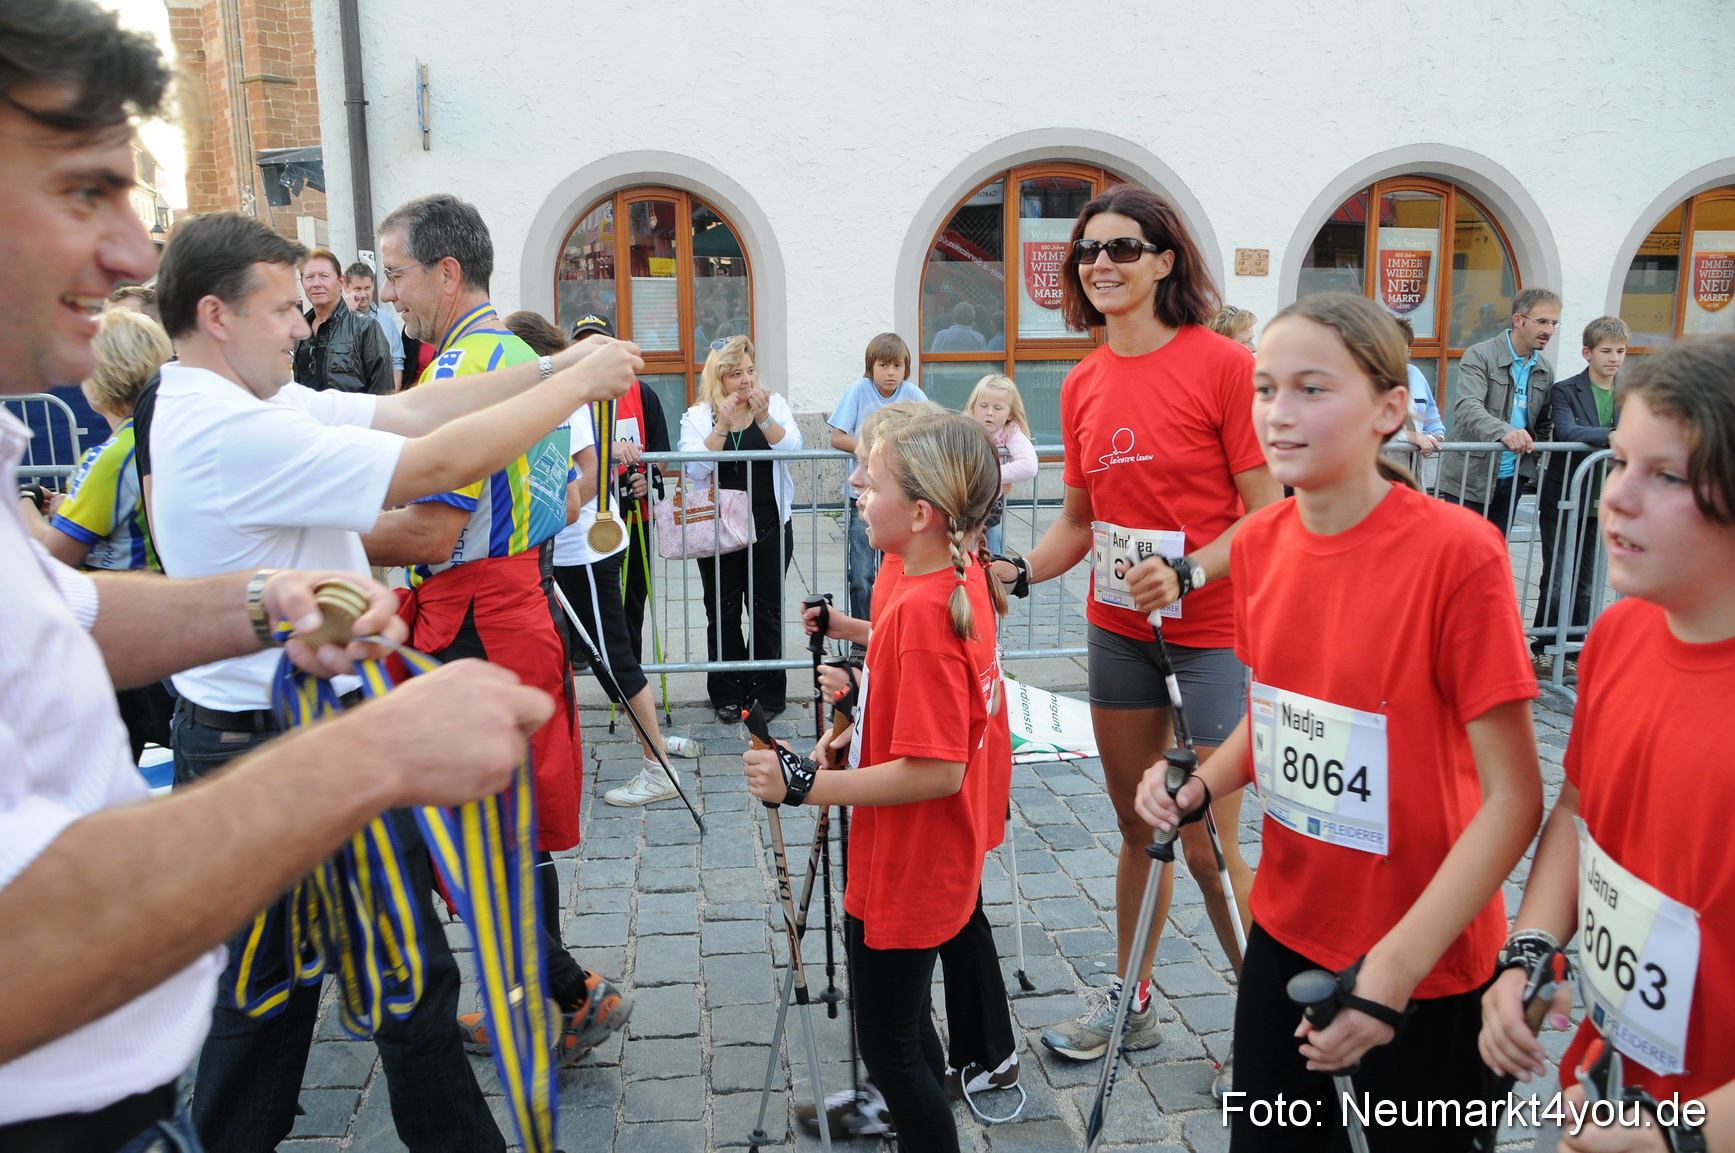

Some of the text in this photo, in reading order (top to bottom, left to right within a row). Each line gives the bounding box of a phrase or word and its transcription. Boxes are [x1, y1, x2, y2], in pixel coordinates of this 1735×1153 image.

[1031, 229, 1071, 240] Wir feier
[1387, 239, 1426, 248] Wir feiern
[1032, 252, 1066, 260] IMME
[1030, 262, 1061, 272] WIED
[1388, 258, 1423, 268] IMMER
[1701, 260, 1734, 268] IMMER
[1386, 268, 1424, 278] WIEDER
[1700, 270, 1734, 278] WIEDER
[1034, 274, 1059, 287] NE
[1388, 280, 1422, 292] NEU
[1700, 280, 1731, 292] NEU
[1388, 294, 1420, 302] MARKT
[1699, 294, 1730, 302] MARKT
[1113, 532, 1152, 552] Anea
[1097, 552, 1102, 562] N
[1282, 702, 1324, 741] Nadja
[1256, 732, 1264, 752] N
[784, 754, 812, 780] LEKI
[1283, 746, 1372, 803] 8064
[1322, 820, 1384, 845] PFLEIDERER
[774, 852, 790, 901] LEKI
[1587, 857, 1618, 910] Jana
[1584, 908, 1668, 1011] 8063
[1606, 1015, 1678, 1068] PFLEIDERER
